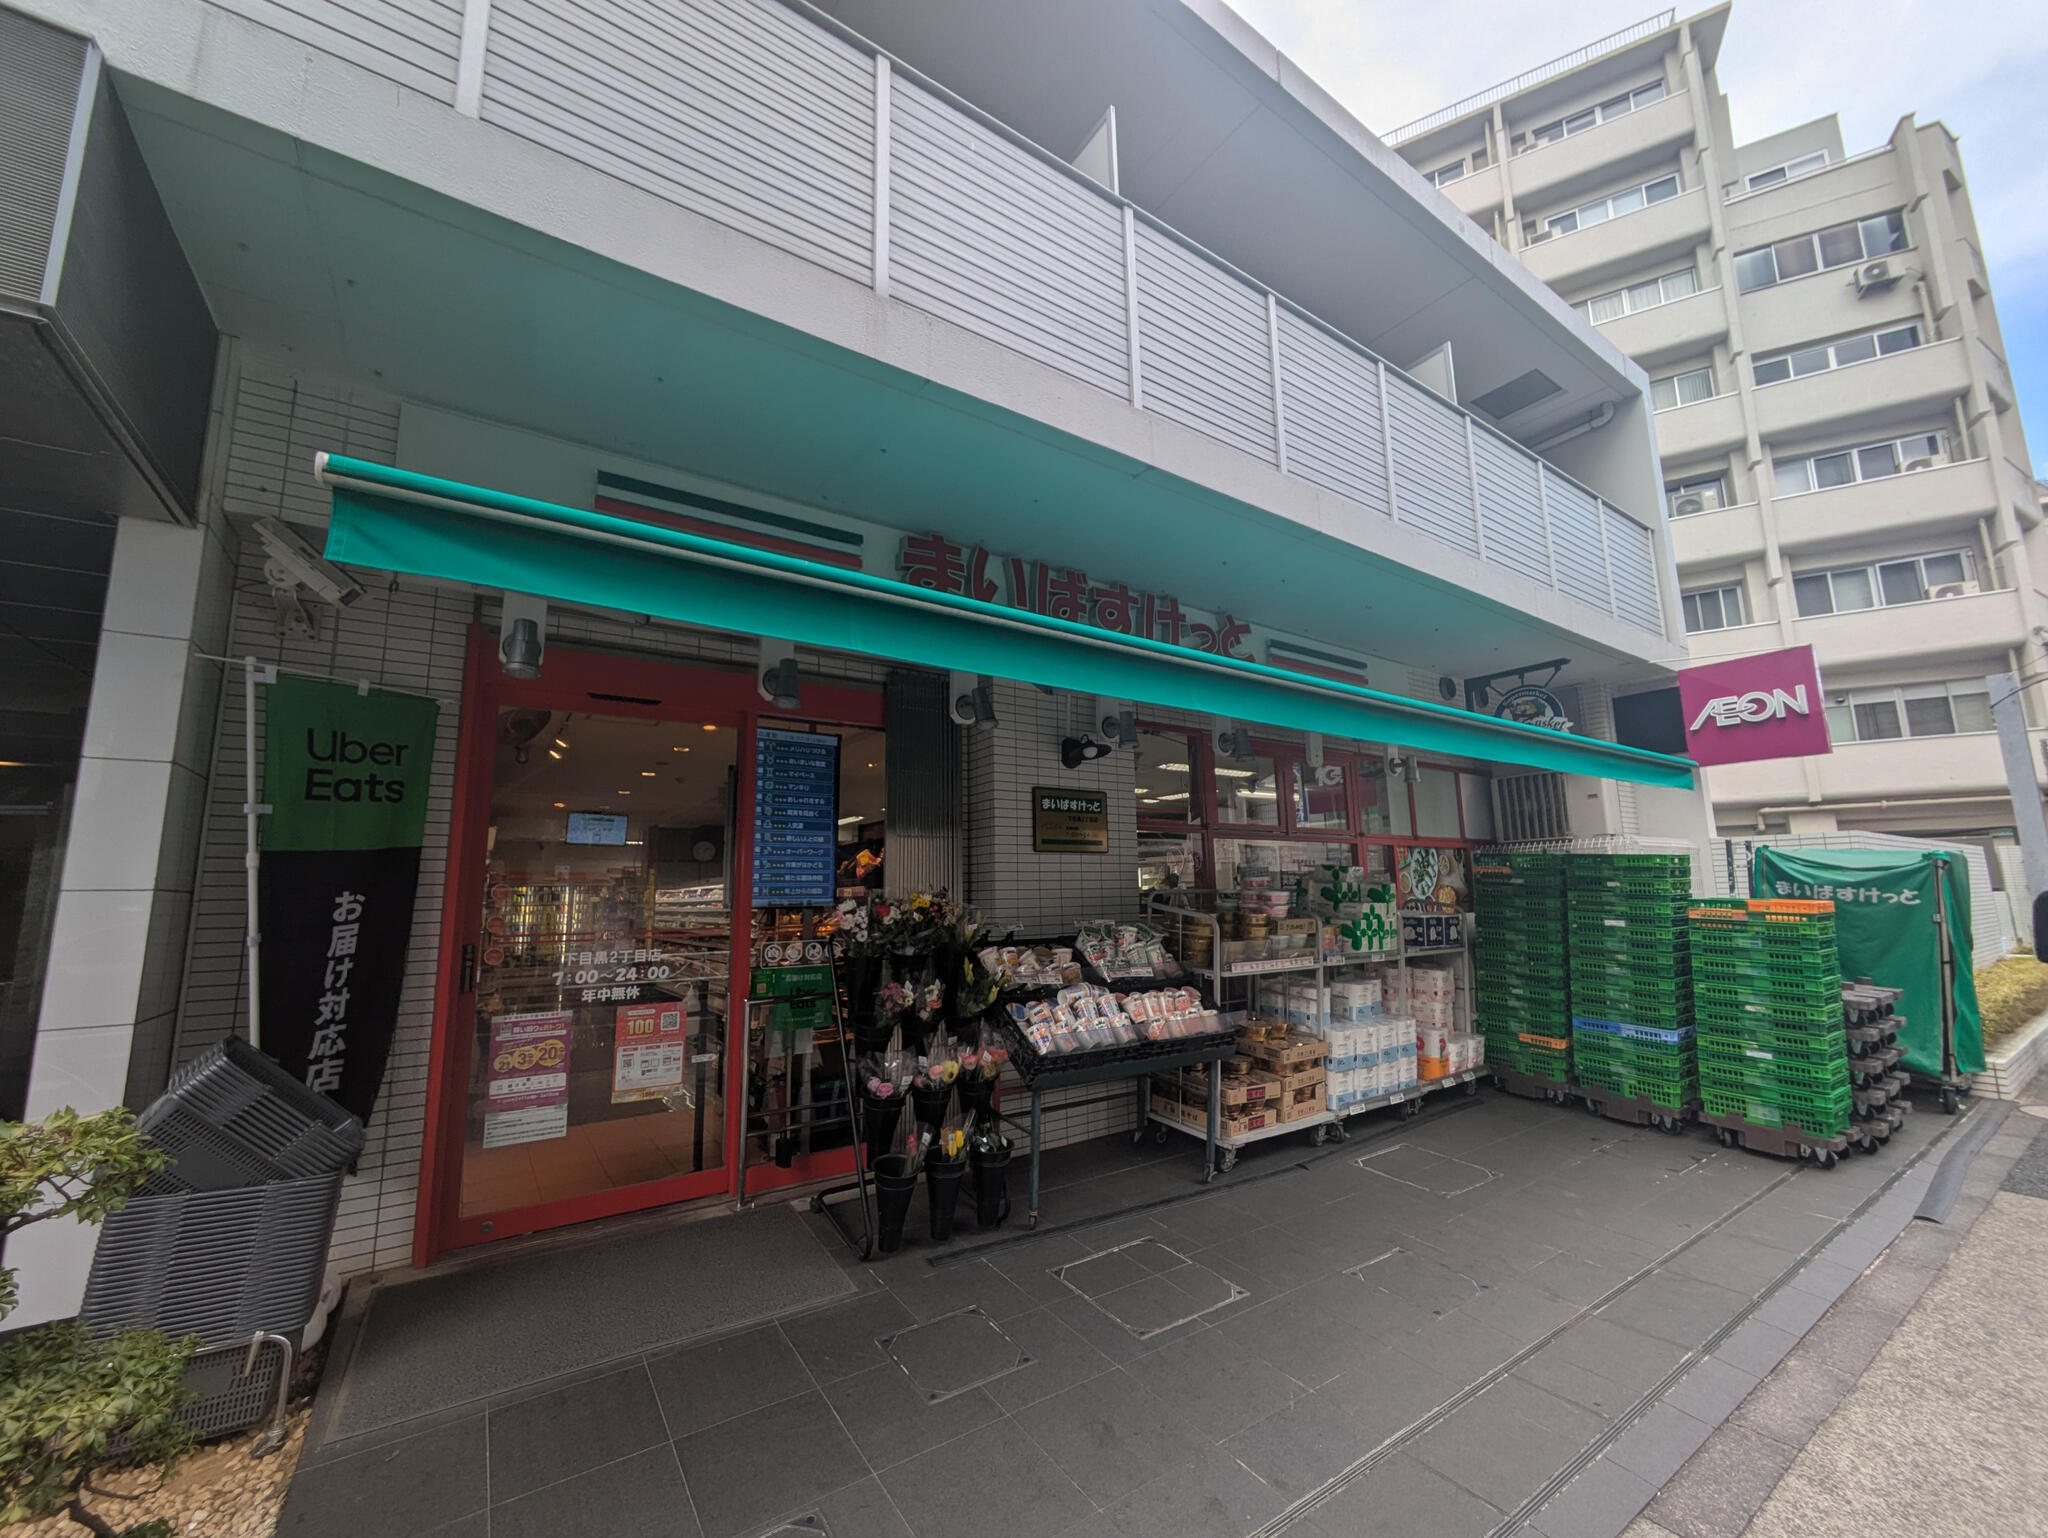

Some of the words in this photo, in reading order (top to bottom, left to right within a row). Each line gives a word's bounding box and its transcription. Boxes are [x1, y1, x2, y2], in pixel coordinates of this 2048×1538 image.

[899, 533, 1256, 663] まいばすけっと
[1689, 683, 1810, 732] AEON
[307, 727, 409, 767] Uber
[304, 768, 405, 803] Eats
[1041, 798, 1101, 812] まいばすけっと
[1775, 880, 1922, 906] まいばすけっと
[565, 948, 662, 967] 下目黒2丁目店
[304, 889, 366, 1095] お届け対応店
[581, 986, 640, 1003] 年中無休
[626, 1018, 655, 1036] 100
